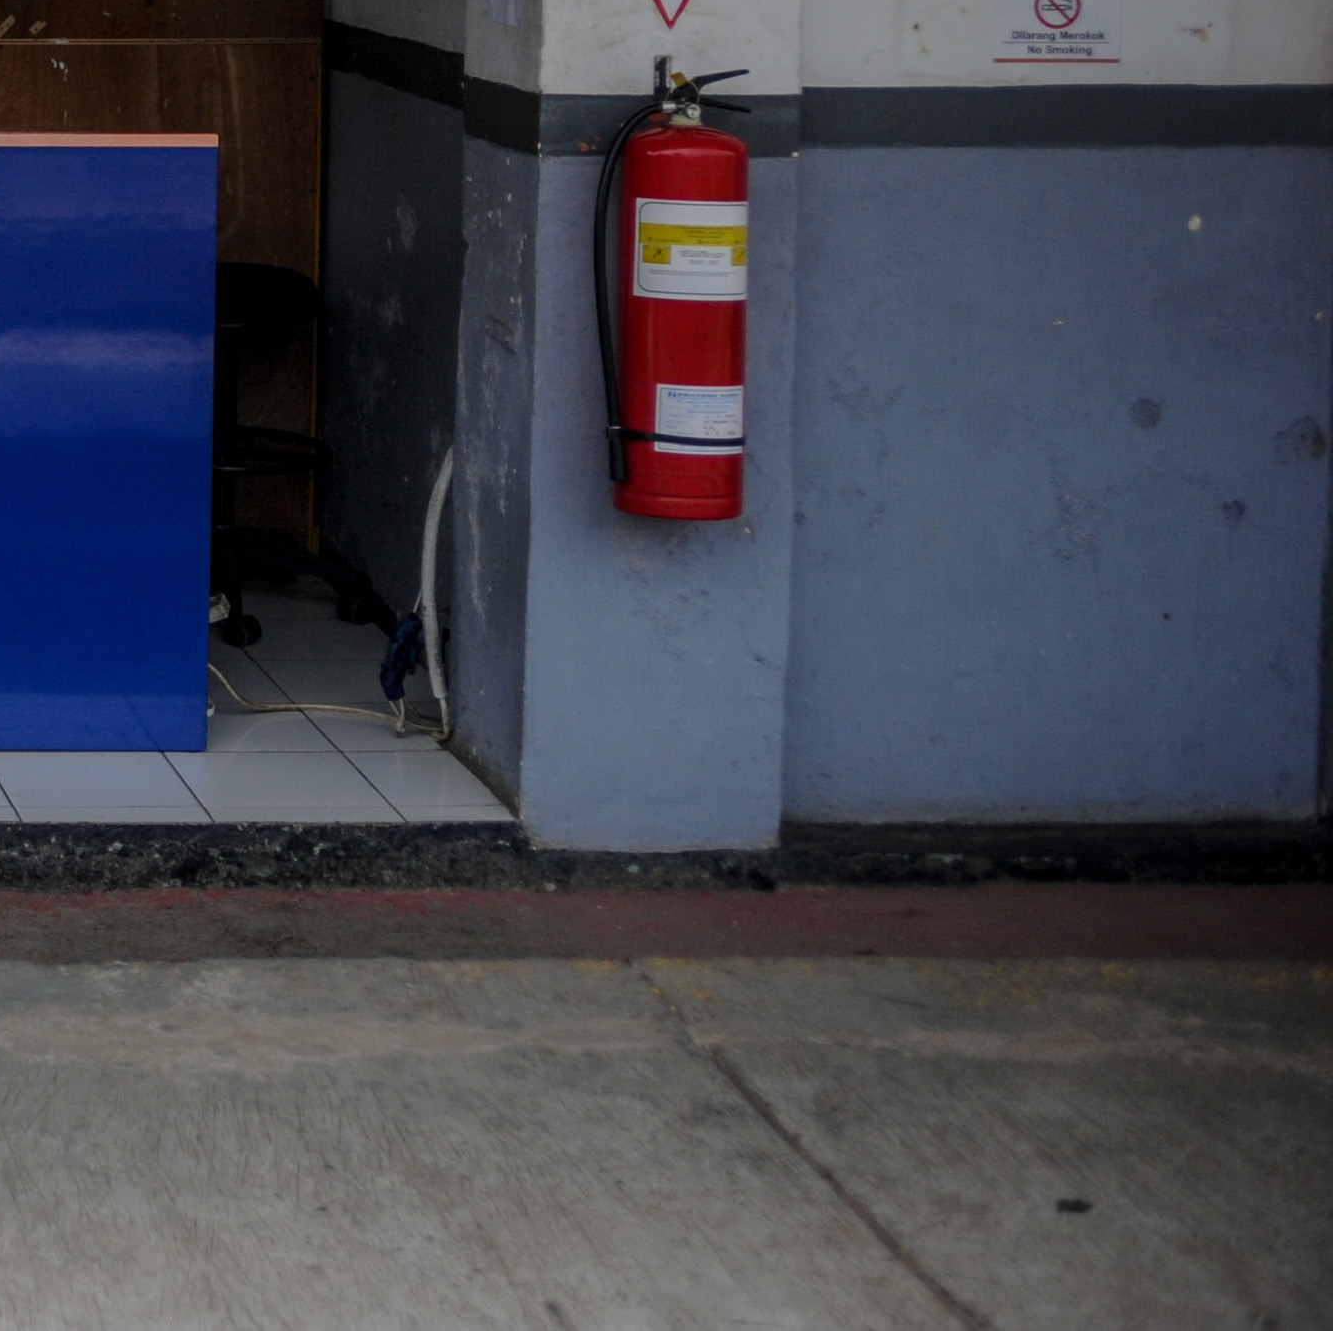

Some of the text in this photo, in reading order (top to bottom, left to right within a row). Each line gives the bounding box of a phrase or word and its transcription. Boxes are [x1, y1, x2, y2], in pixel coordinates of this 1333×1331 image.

[1011, 30, 1105, 42] Dilarang Merokok
[1027, 45, 1093, 57] No Smoking
